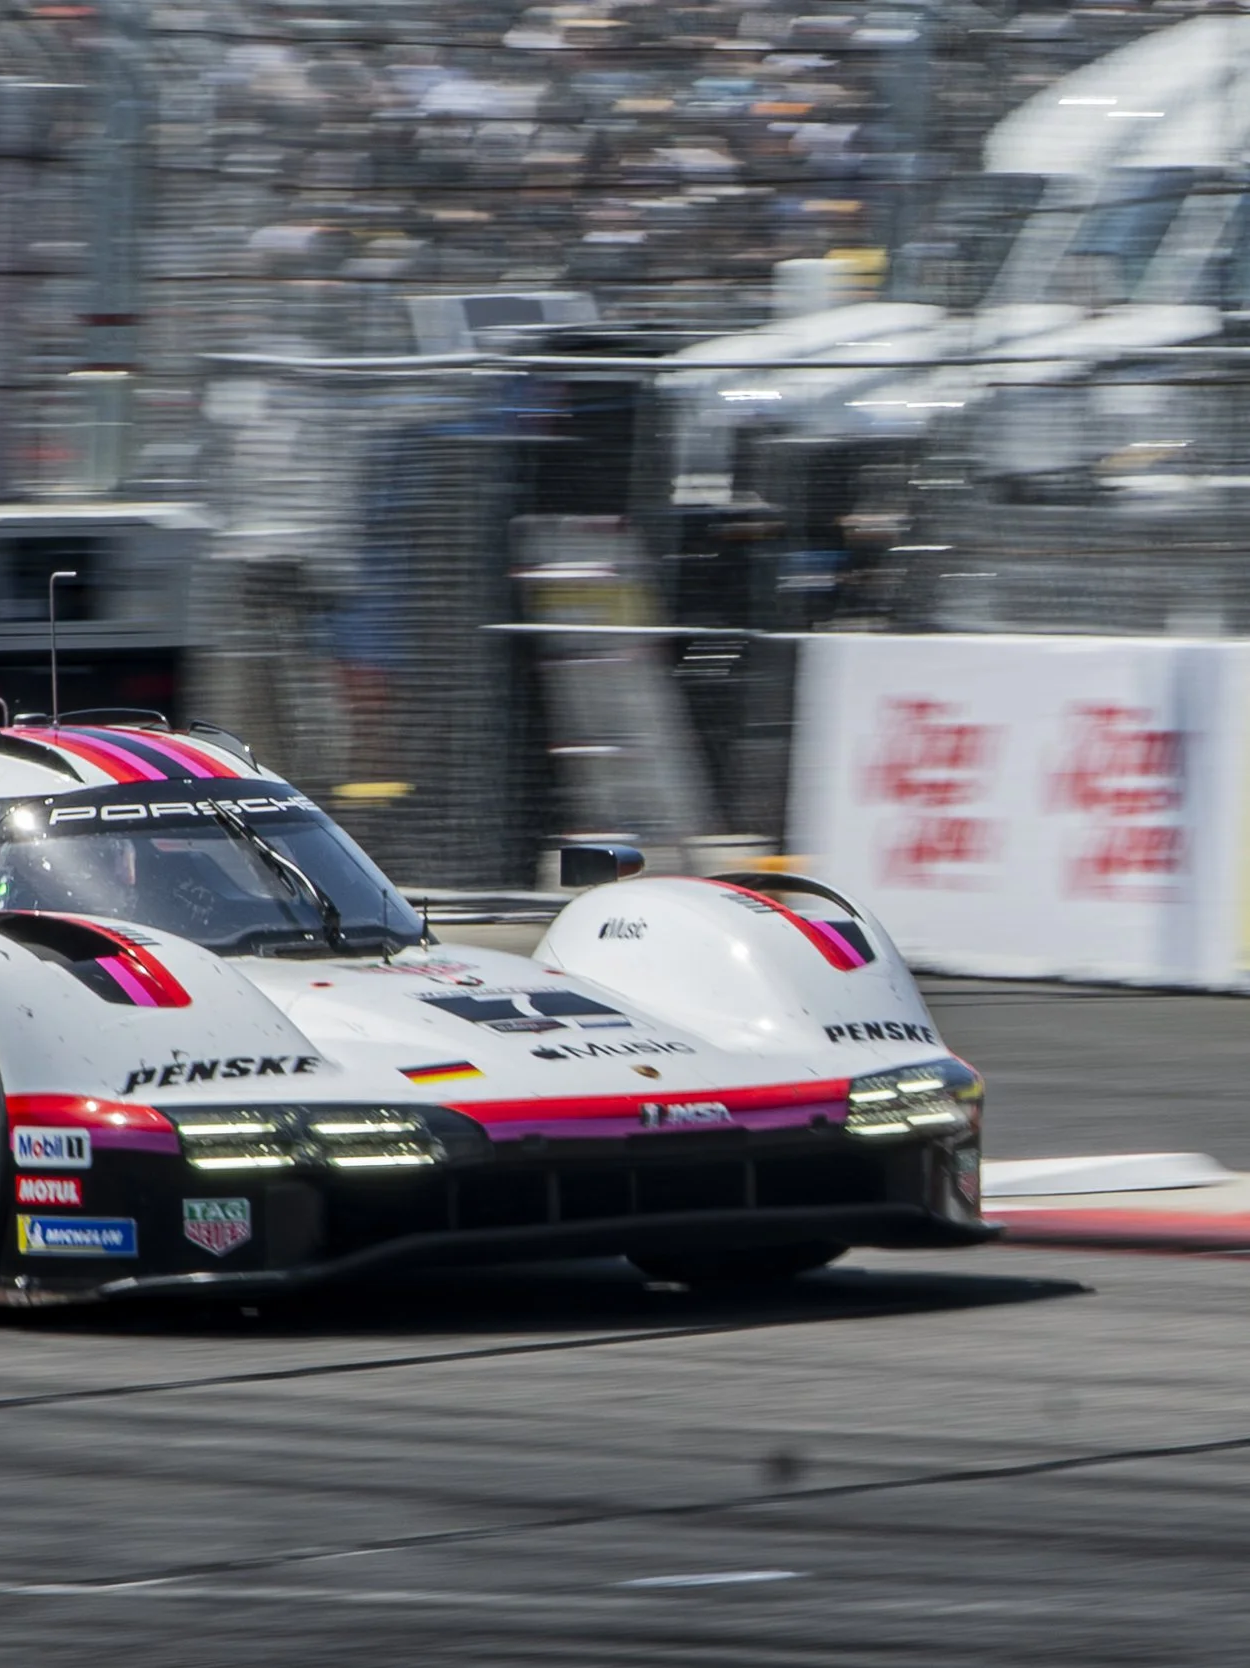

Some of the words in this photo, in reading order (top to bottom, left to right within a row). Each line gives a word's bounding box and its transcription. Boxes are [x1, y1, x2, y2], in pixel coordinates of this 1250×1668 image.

[49, 795, 321, 826] PORSCHE
[823, 1021, 939, 1045] PENSKE
[558, 1039, 697, 1059] Music
[120, 1055, 323, 1096] PENSKE
[19, 1133, 63, 1158] Mobil
[66, 1136, 84, 1158] 1
[19, 1178, 81, 1205] MOTUL
[187, 1201, 247, 1219] TAG
